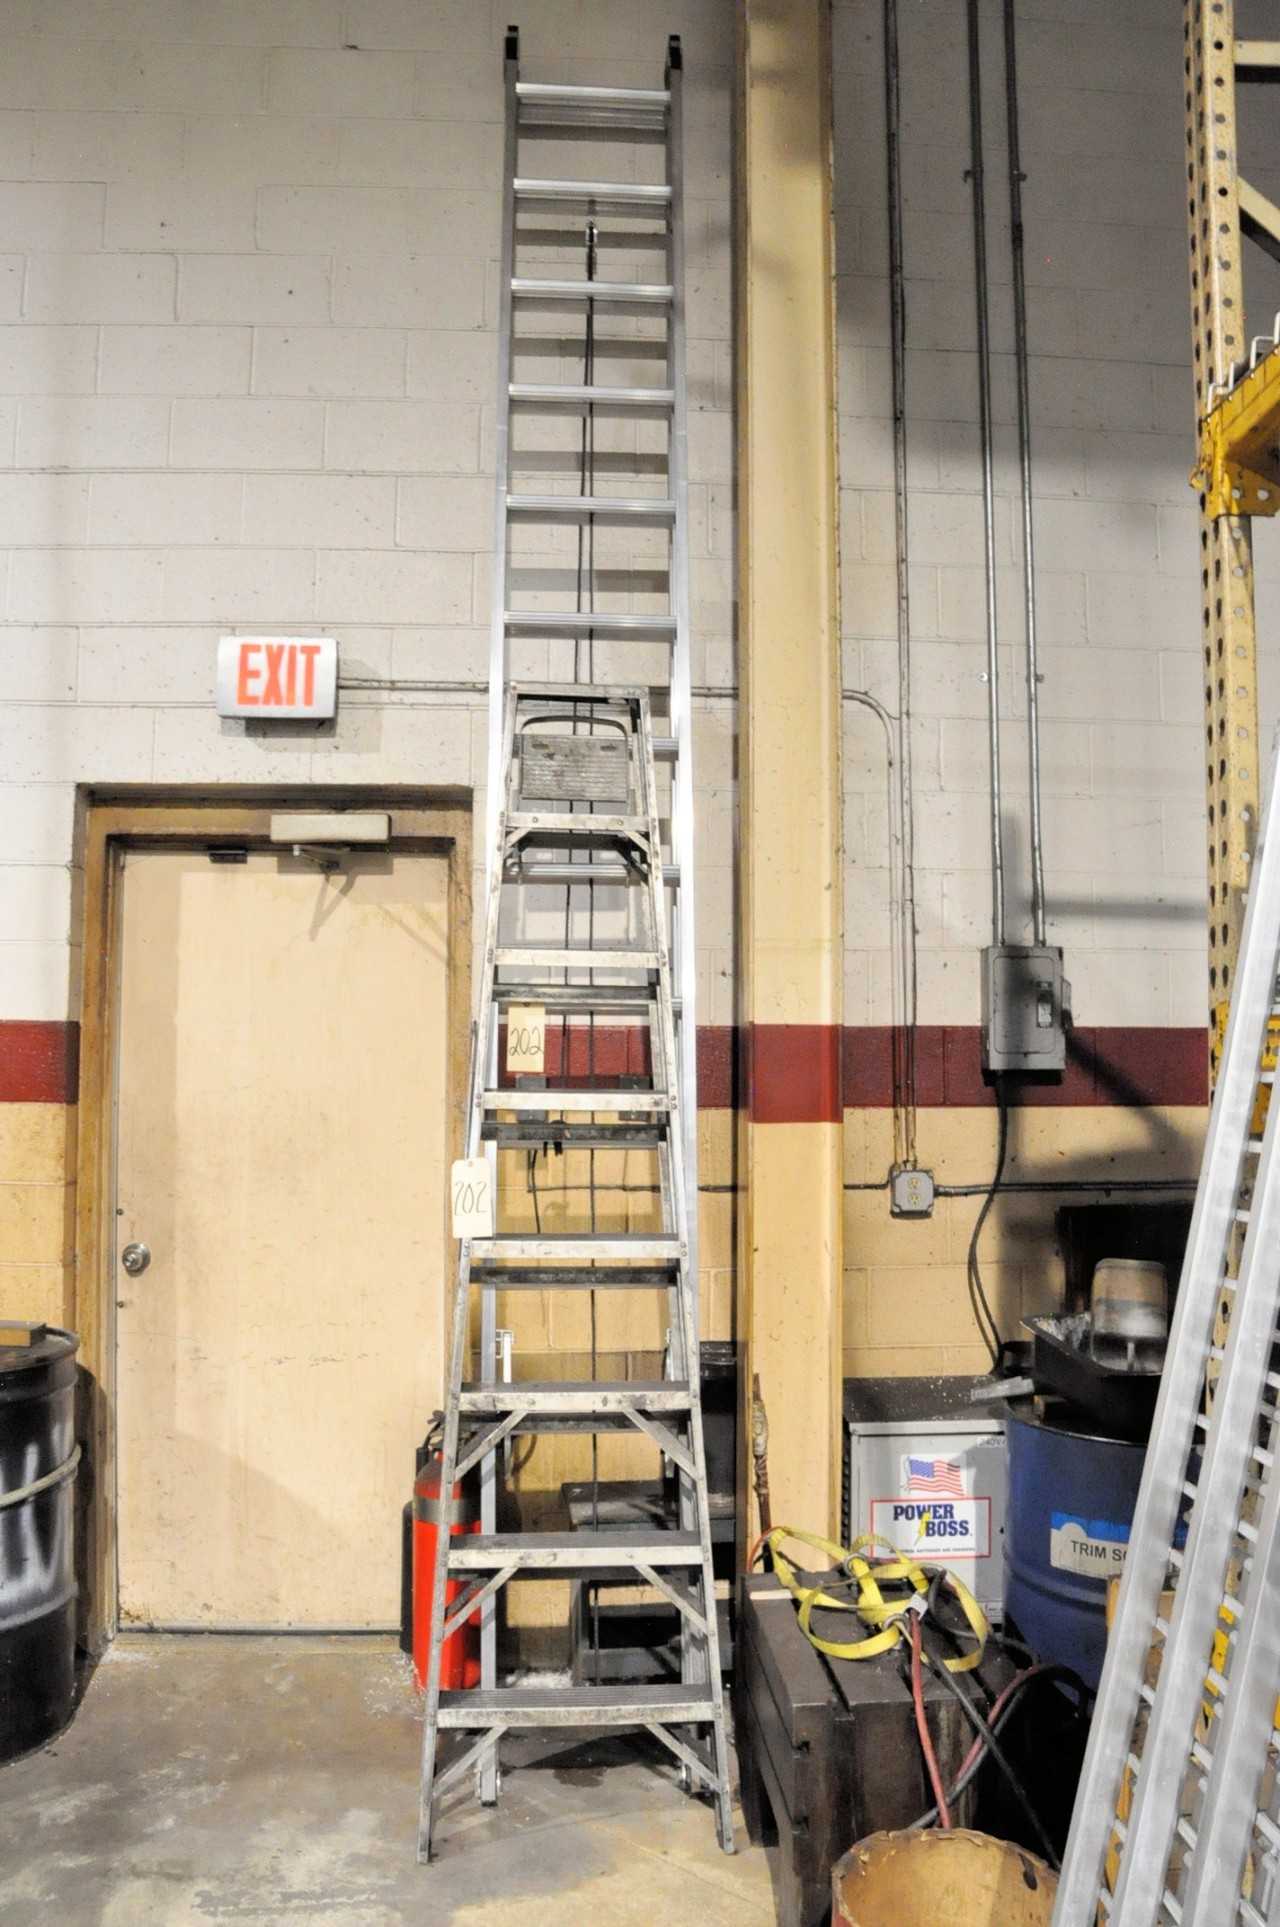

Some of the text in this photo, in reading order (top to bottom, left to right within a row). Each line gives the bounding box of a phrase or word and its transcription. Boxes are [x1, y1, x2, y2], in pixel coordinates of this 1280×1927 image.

[237, 643, 321, 706] EXIT
[509, 1027, 545, 1057] 202
[892, 1504, 954, 1521] POWER
[925, 1520, 969, 1537] BOSS
[1071, 1540, 1107, 1559] TRIM
